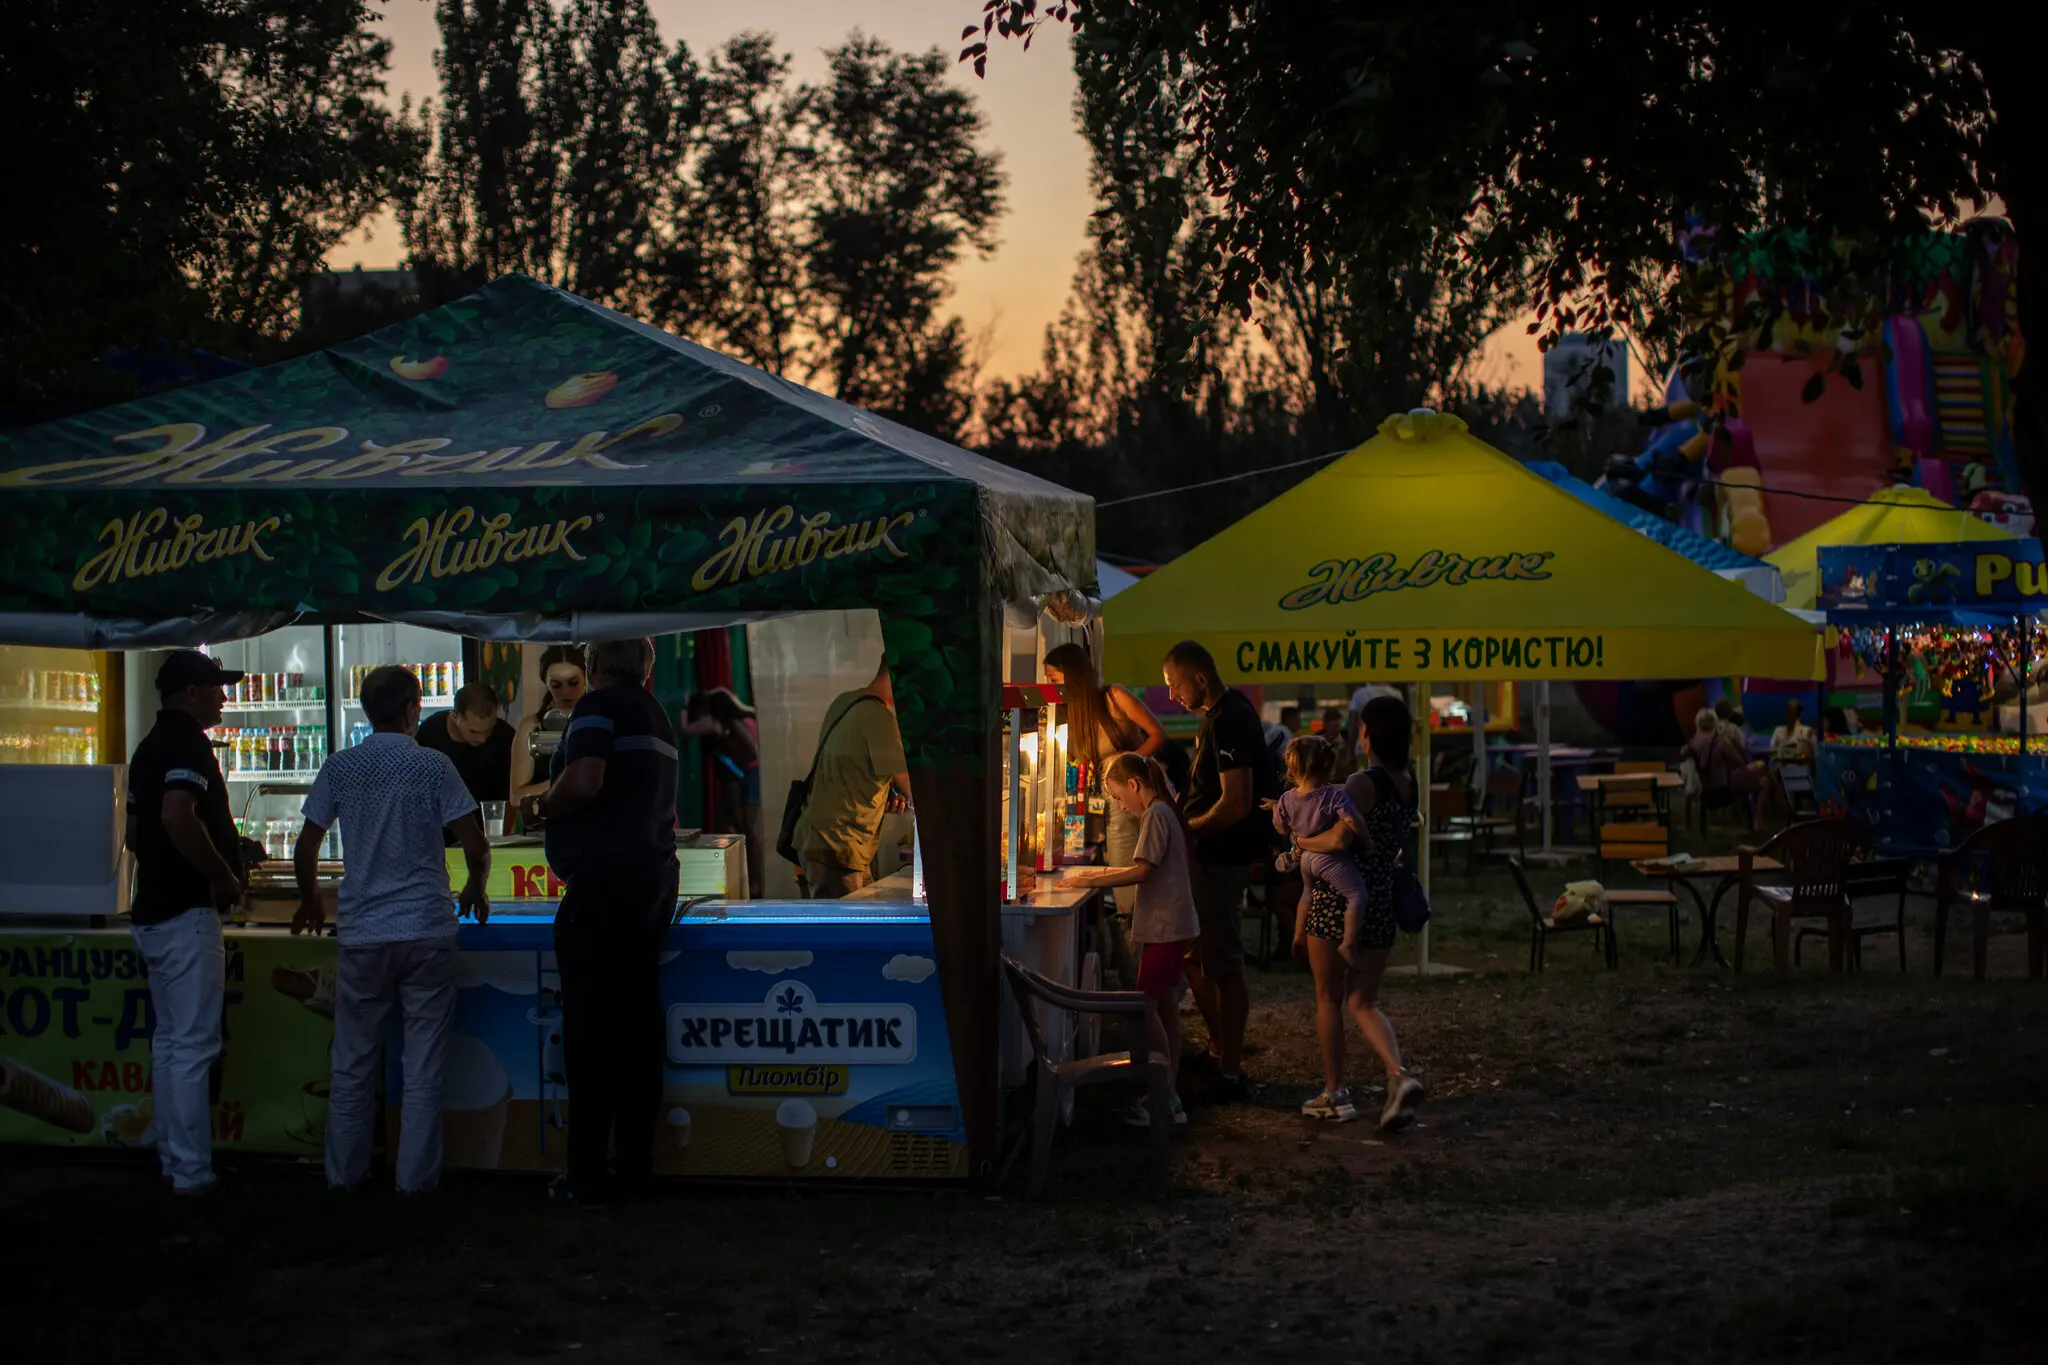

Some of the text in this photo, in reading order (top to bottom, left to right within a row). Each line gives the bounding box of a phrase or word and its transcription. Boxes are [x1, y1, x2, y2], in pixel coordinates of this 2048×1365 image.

[0, 413, 685, 484] Живчик
[72, 507, 281, 593] Живчик
[375, 506, 591, 593] Живчик
[691, 505, 914, 592] Живчик
[1279, 551, 1553, 611] Живчик
[1236, 630, 1401, 673] СМАКУЙТЕ
[1443, 633, 1603, 669] КОРИСТЮ!
[682, 1017, 902, 1054] ХРЕЩАТИК
[72, 1061, 153, 1093] КАВ
[738, 1065, 840, 1093] Пломбір
